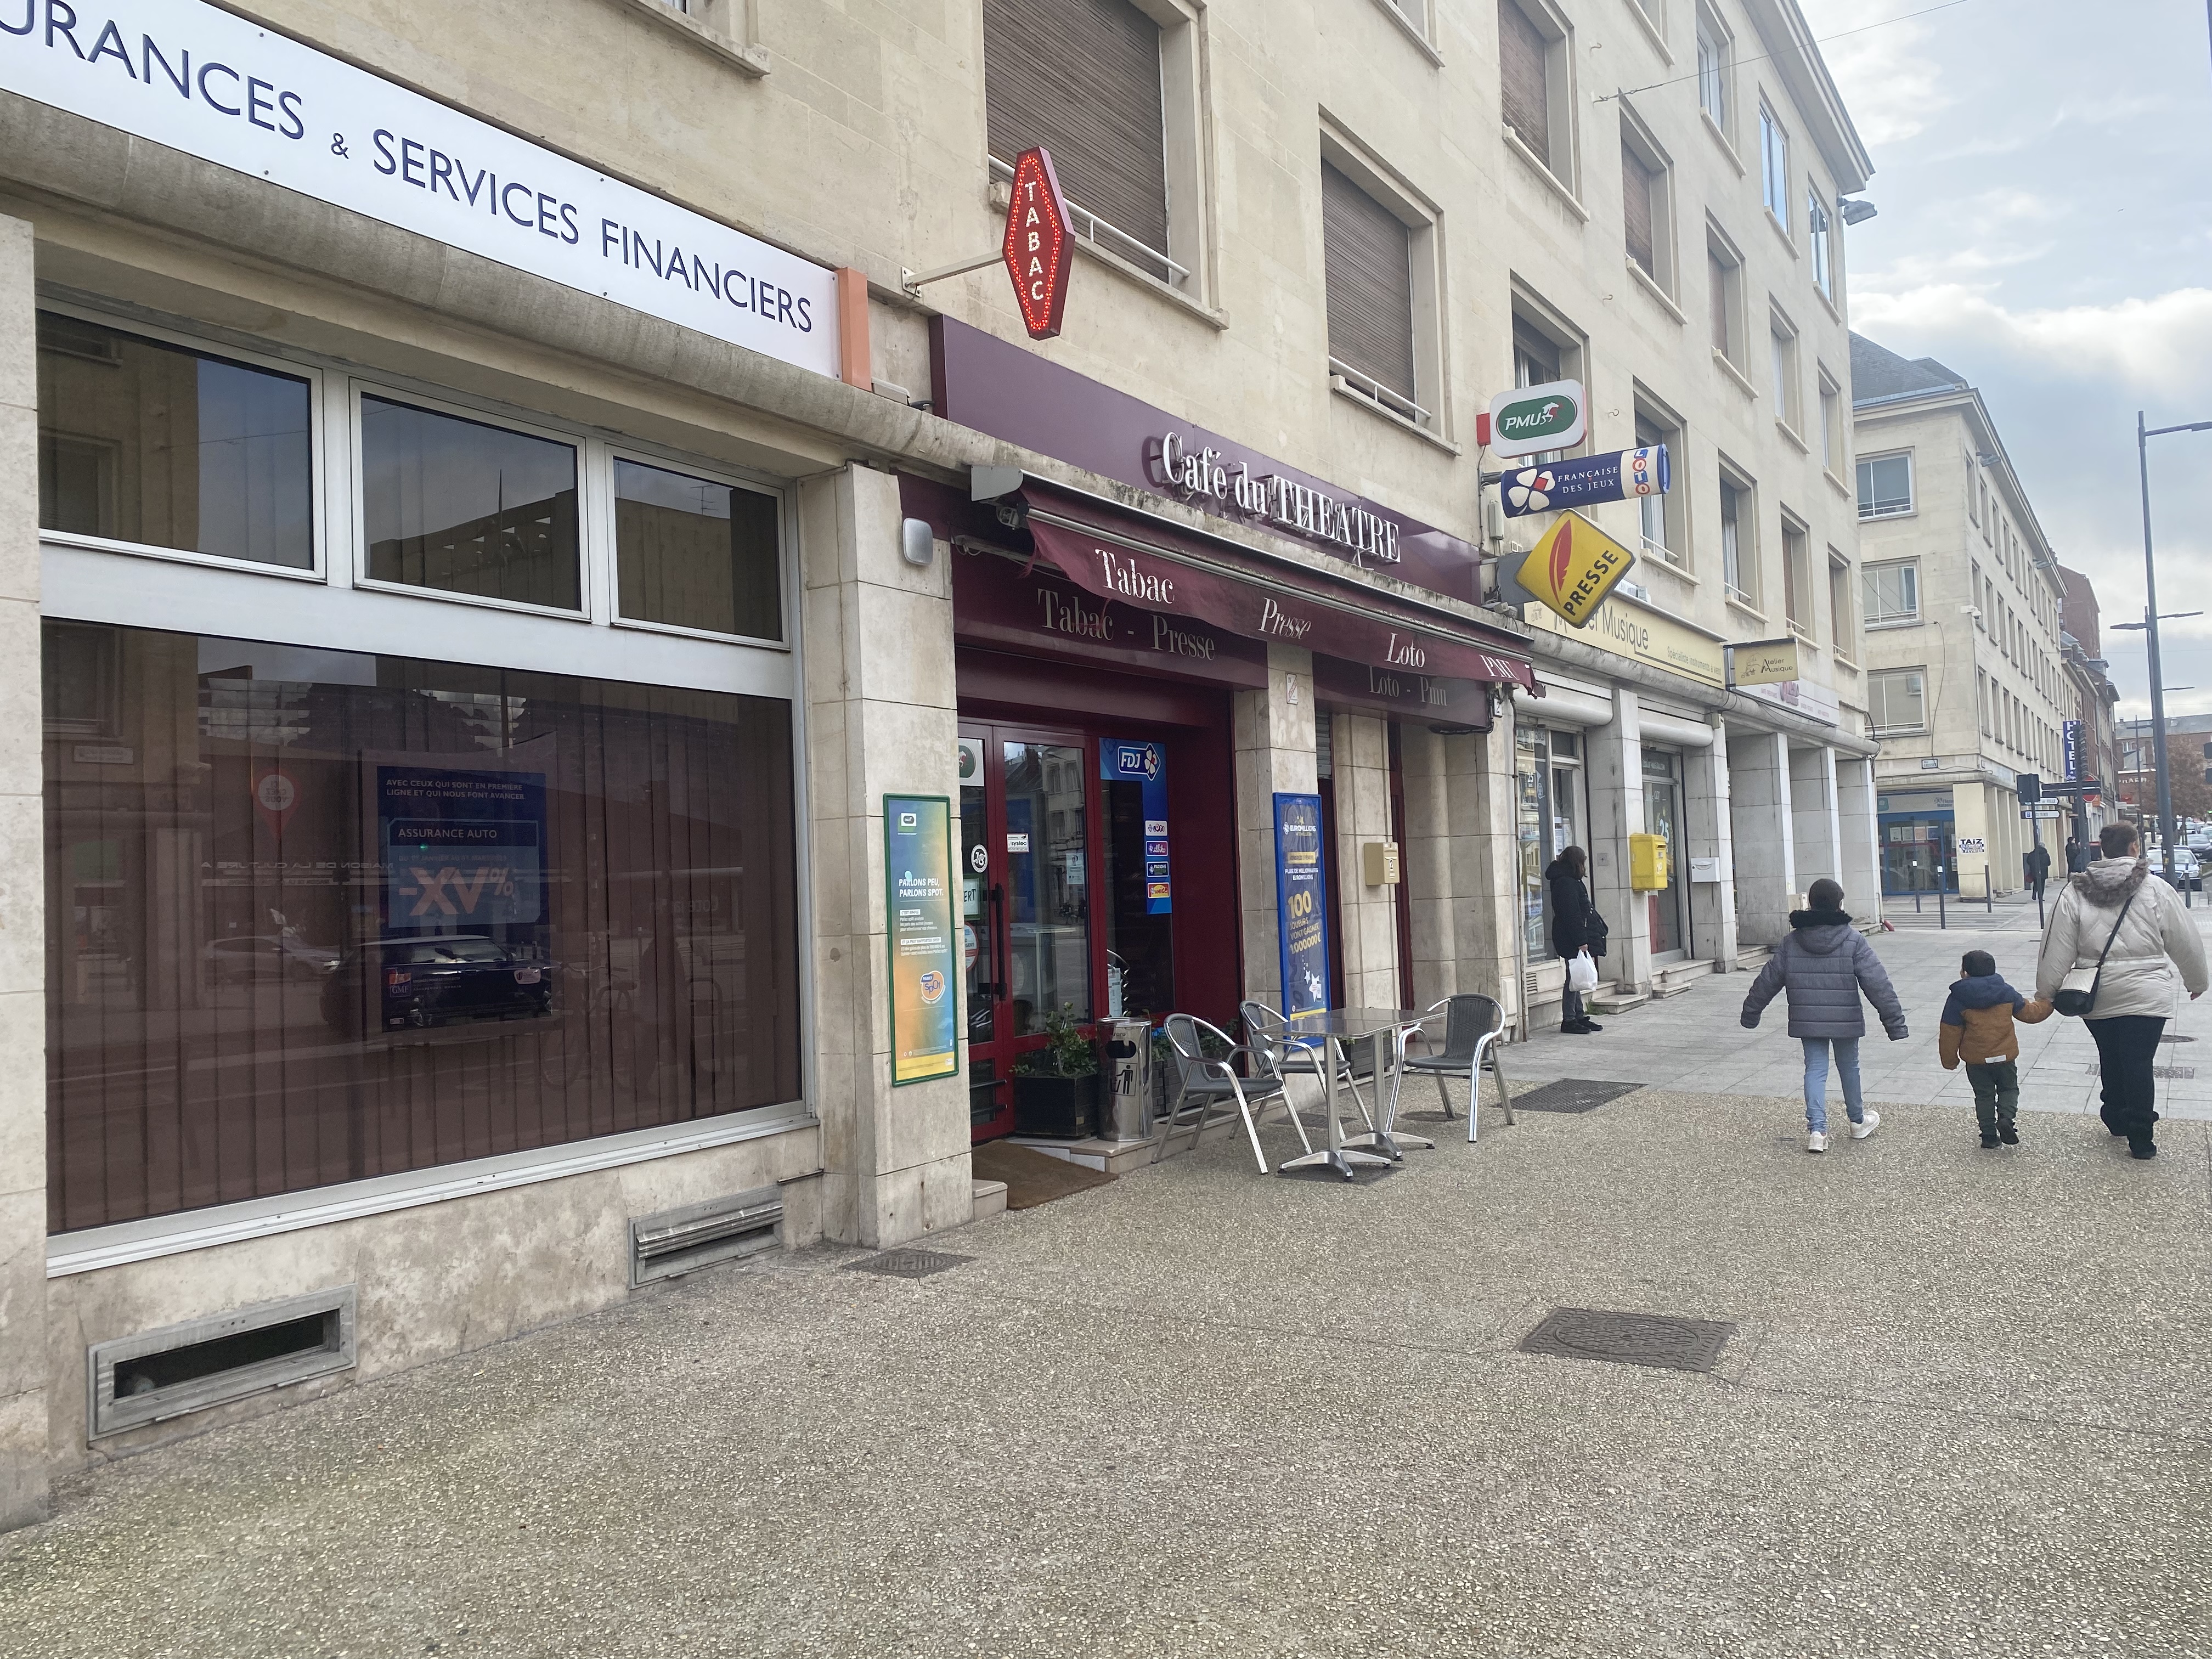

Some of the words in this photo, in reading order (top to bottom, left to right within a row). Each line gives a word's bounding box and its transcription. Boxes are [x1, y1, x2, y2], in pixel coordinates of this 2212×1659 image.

[330, 132, 349, 160] &
[373, 129, 579, 245] SERVICES
[601, 217, 812, 333] FINANCIERS
[1024, 180, 1044, 301] TABAC
[1505, 413, 1542, 431] PMU
[1162, 431, 1228, 499] Café
[1235, 461, 1268, 516] du
[1558, 466, 1619, 483] FRANÇAISE
[1632, 449, 1651, 495] LOTO
[1562, 483, 1582, 494] DES
[1587, 478, 1615, 492] JEUX
[1562, 550, 1619, 617] PRESSE
[1095, 549, 1176, 605] Tabac
[1257, 597, 1312, 640] Presse
[1384, 632, 1426, 668] Loto
[1602, 602, 1649, 653] Musique
[1037, 588, 1114, 641] Tabac
[1150, 613, 1215, 661] Presse
[1369, 665, 1400, 698] Loto
[1760, 665, 1793, 674] Musique
[1121, 752, 1141, 769] FDJ
[435, 781, 450, 789] QUI
[452, 781, 473, 789] SONT
[398, 828, 465, 838] ASSURANCE
[467, 828, 498, 839] AUTO
[1389, 860, 1394, 870] 2
[899, 878, 927, 887] PARLONS
[927, 878, 940, 888] PEU,
[899, 888, 927, 898] PARLONS
[927, 888, 944, 898] SPOT.
[1288, 890, 1312, 919] 100
[1290, 917, 1309, 930] JOUEURS
[1290, 929, 1304, 940] VONT
[1303, 922, 1320, 935] GAGNER
[392, 986, 409, 995] GMF
